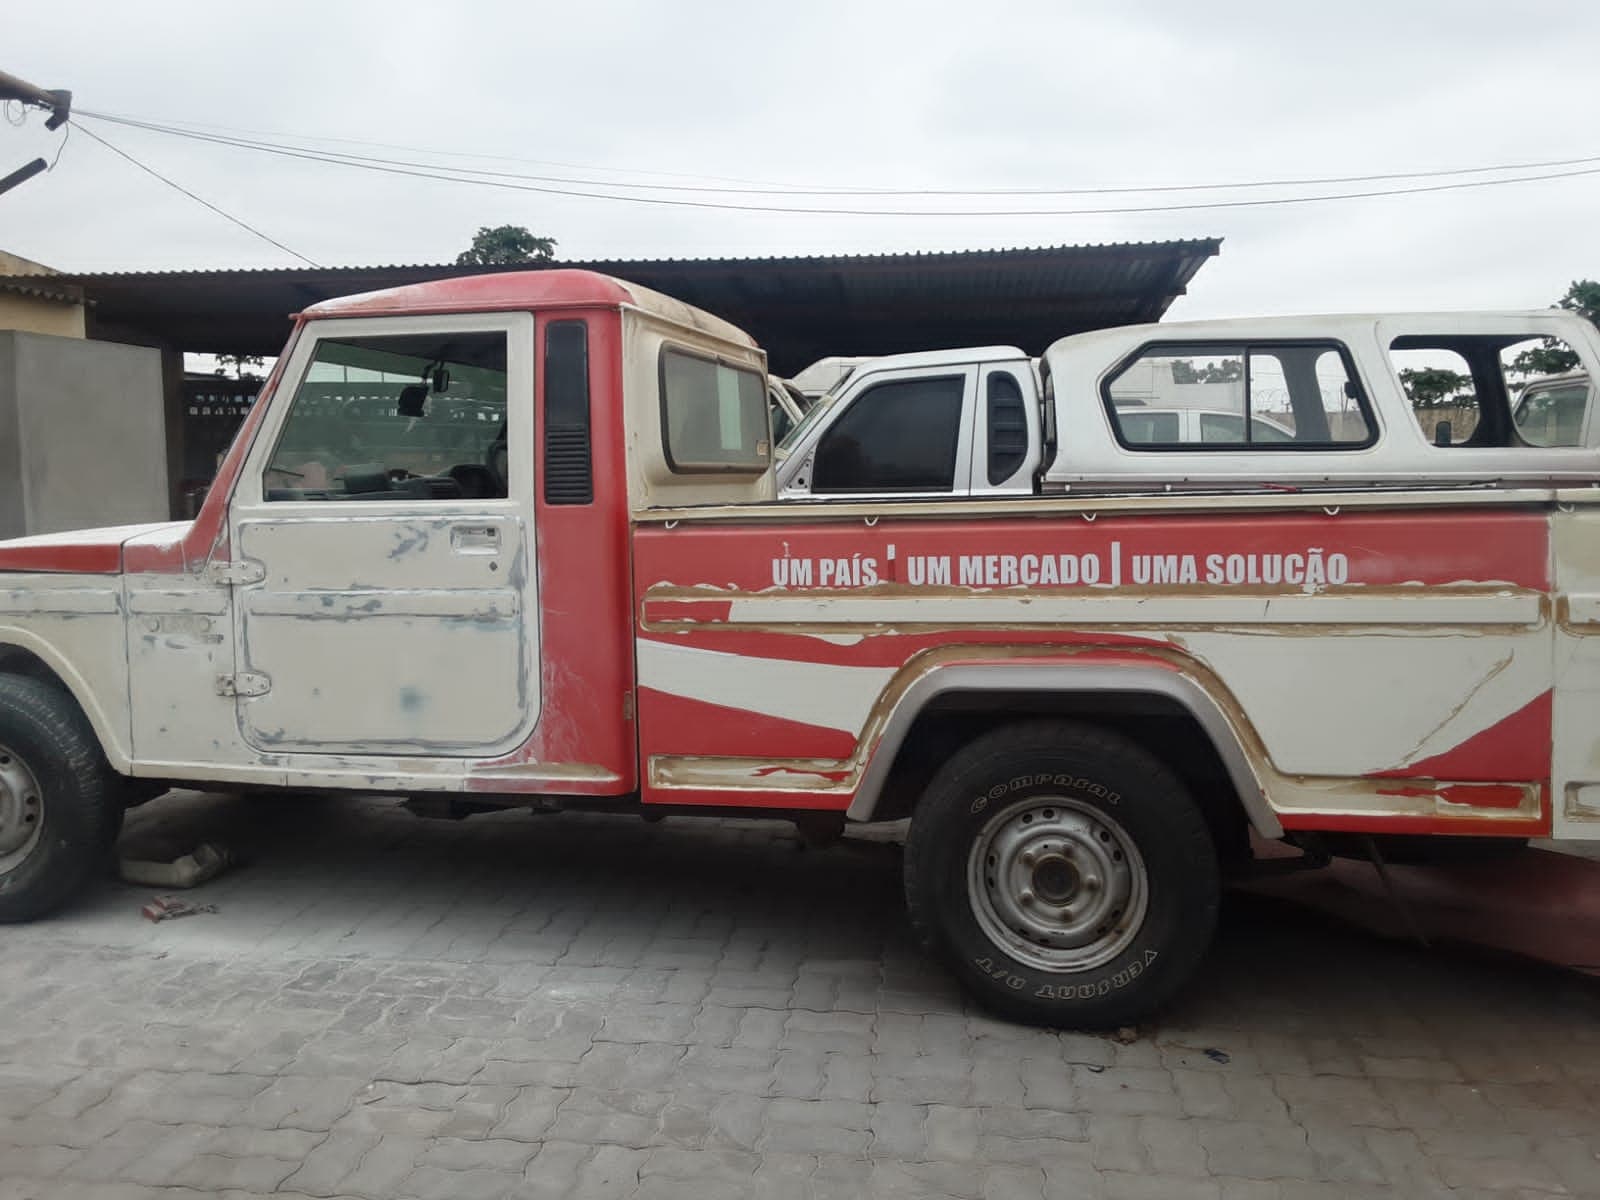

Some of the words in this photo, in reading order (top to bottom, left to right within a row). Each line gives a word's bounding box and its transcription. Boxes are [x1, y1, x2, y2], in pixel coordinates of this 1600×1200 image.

[772, 557, 812, 586] UM
[819, 552, 878, 586] PAÍS
[907, 555, 951, 586] UM
[959, 553, 1100, 586] MERCADO
[1132, 554, 1198, 586] UMA
